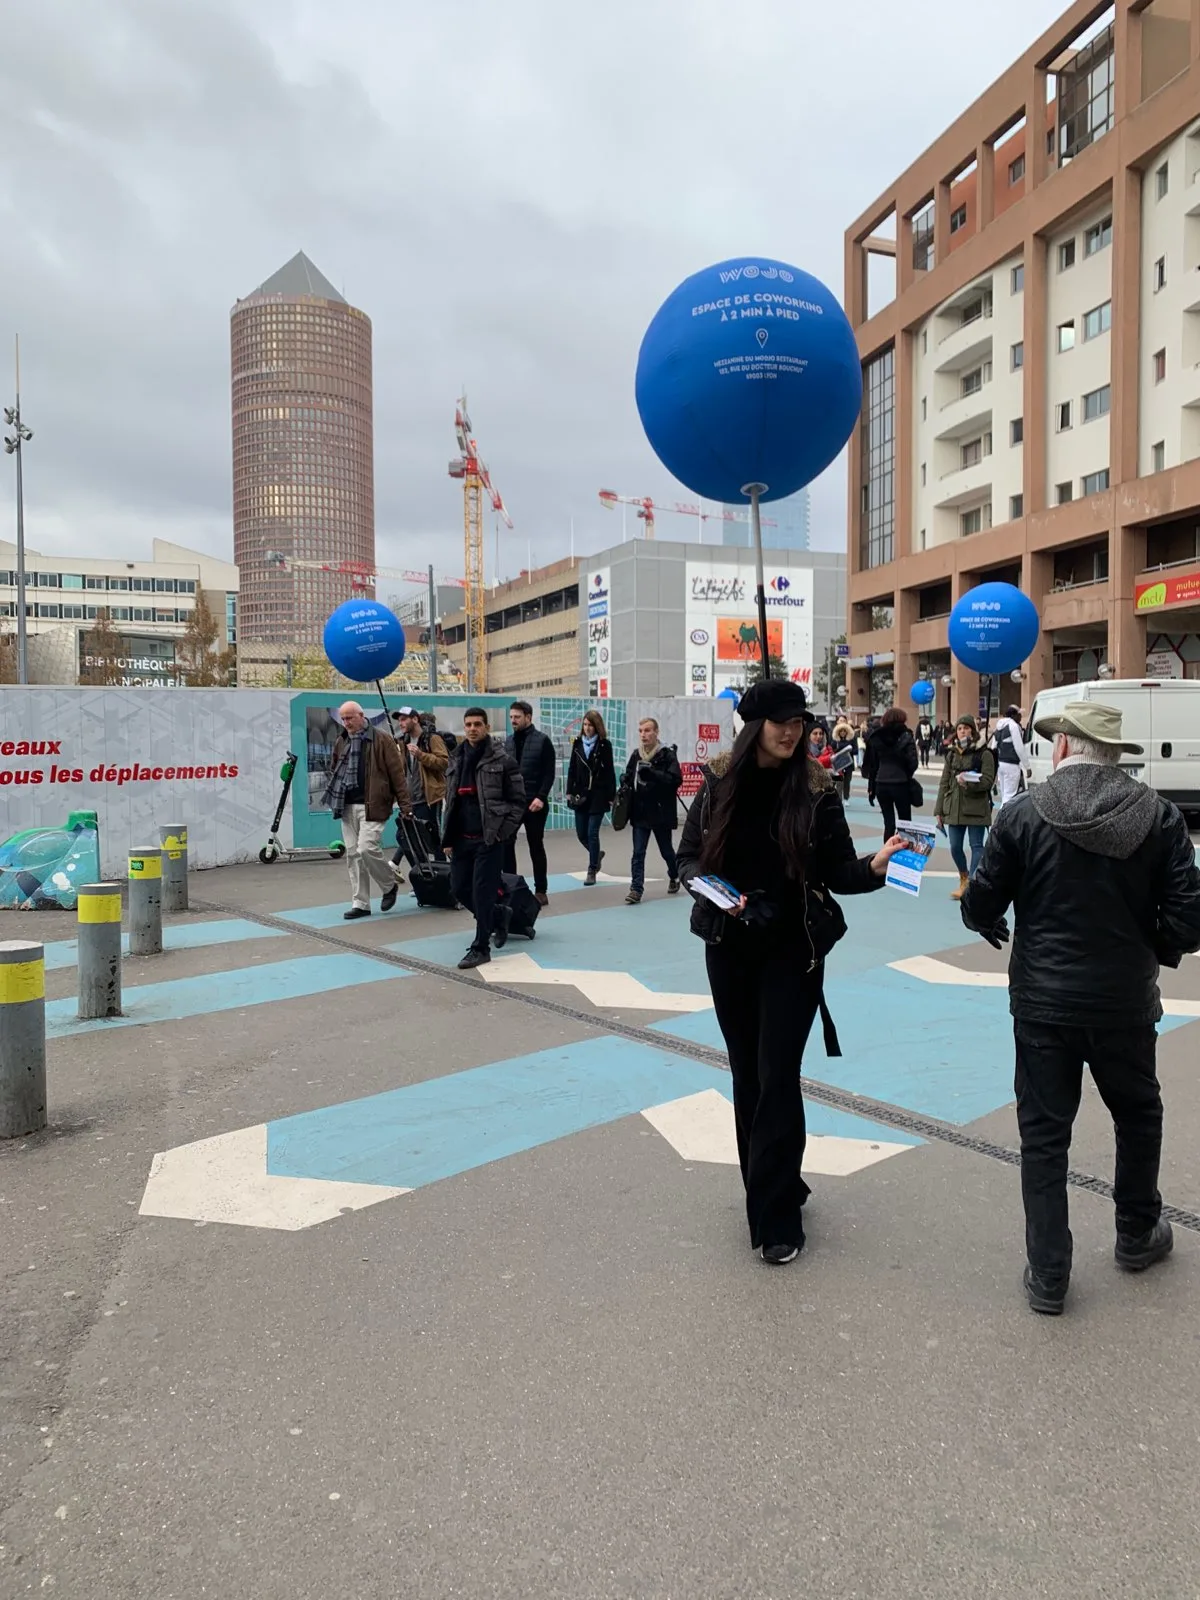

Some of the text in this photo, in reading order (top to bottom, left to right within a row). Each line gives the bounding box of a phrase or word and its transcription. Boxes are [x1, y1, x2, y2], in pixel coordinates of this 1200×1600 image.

[719, 265, 794, 284] WOJO
[691, 293, 823, 317] ESPACE DE COWORKING
[720, 304, 800, 321] À 2 MIN À PIED
[751, 363, 778, 371] DOCTEUR
[776, 355, 808, 367] RESTAURANT
[85, 655, 175, 672] BIBLIOTHÈQUE
[0, 741, 62, 756] eaux
[50, 764, 84, 783] les
[90, 762, 239, 786] déplacements
